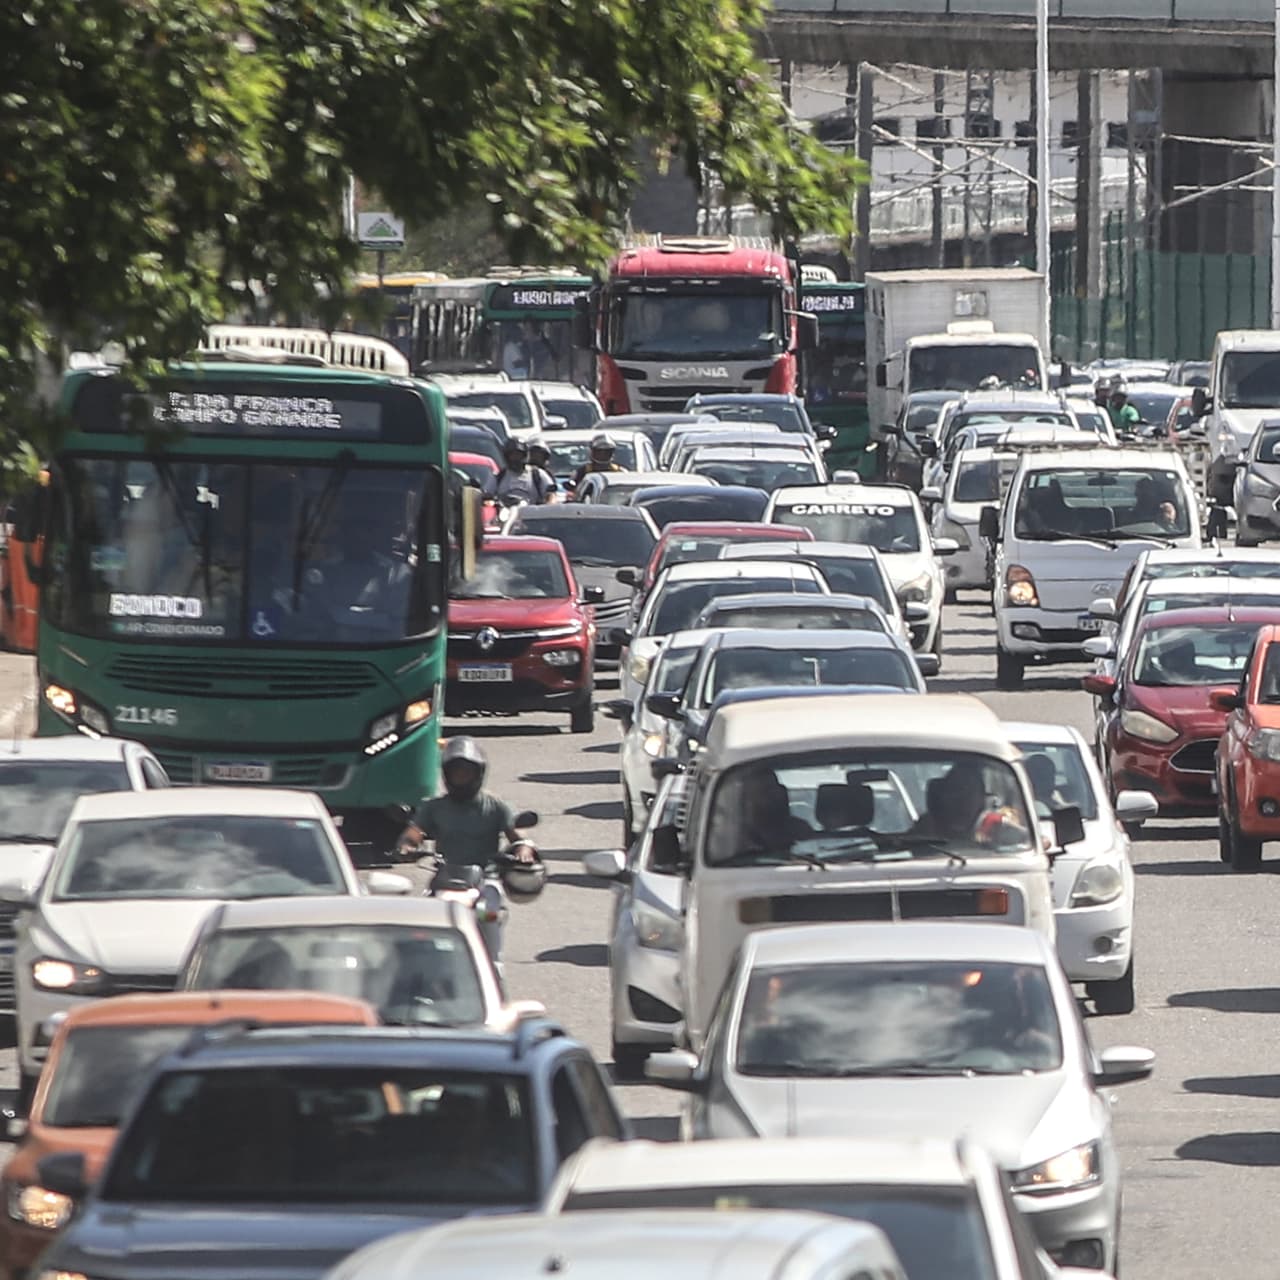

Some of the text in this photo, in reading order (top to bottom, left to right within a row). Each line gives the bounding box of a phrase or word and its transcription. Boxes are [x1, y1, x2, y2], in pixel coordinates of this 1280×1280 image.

[660, 366, 729, 379] SCANIA
[241, 409, 342, 429] GRANDE
[791, 503, 896, 516] CARRETO
